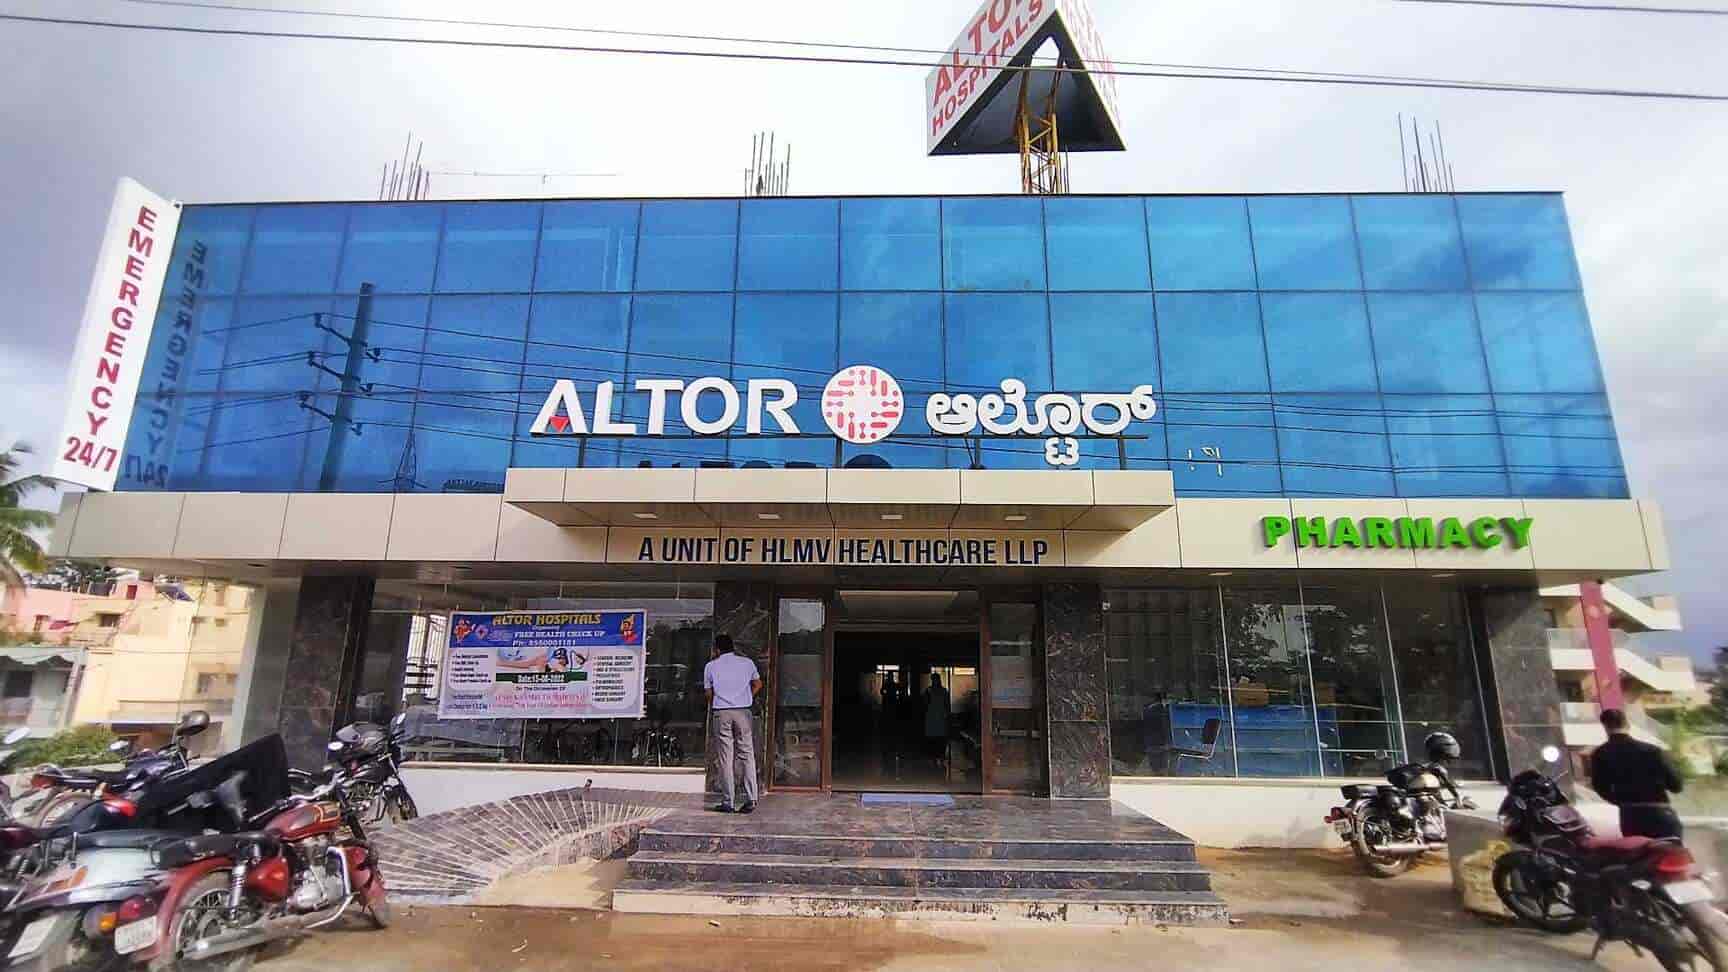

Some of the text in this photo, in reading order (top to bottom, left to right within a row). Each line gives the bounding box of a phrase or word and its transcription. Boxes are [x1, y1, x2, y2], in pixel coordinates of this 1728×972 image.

[932, 0, 1042, 137] HOSPITALS
[933, 0, 1023, 105] ALTO
[86, 205, 157, 436] EMERGENCY
[529, 376, 801, 435] ALTOR
[63, 436, 118, 472] 24/7
[638, 537, 1048, 564] A UNIT OF HLMV HEALTHCARE LLP
[1262, 516, 1534, 549] PHARMACY
[537, 614, 601, 624] HOSPITALS
